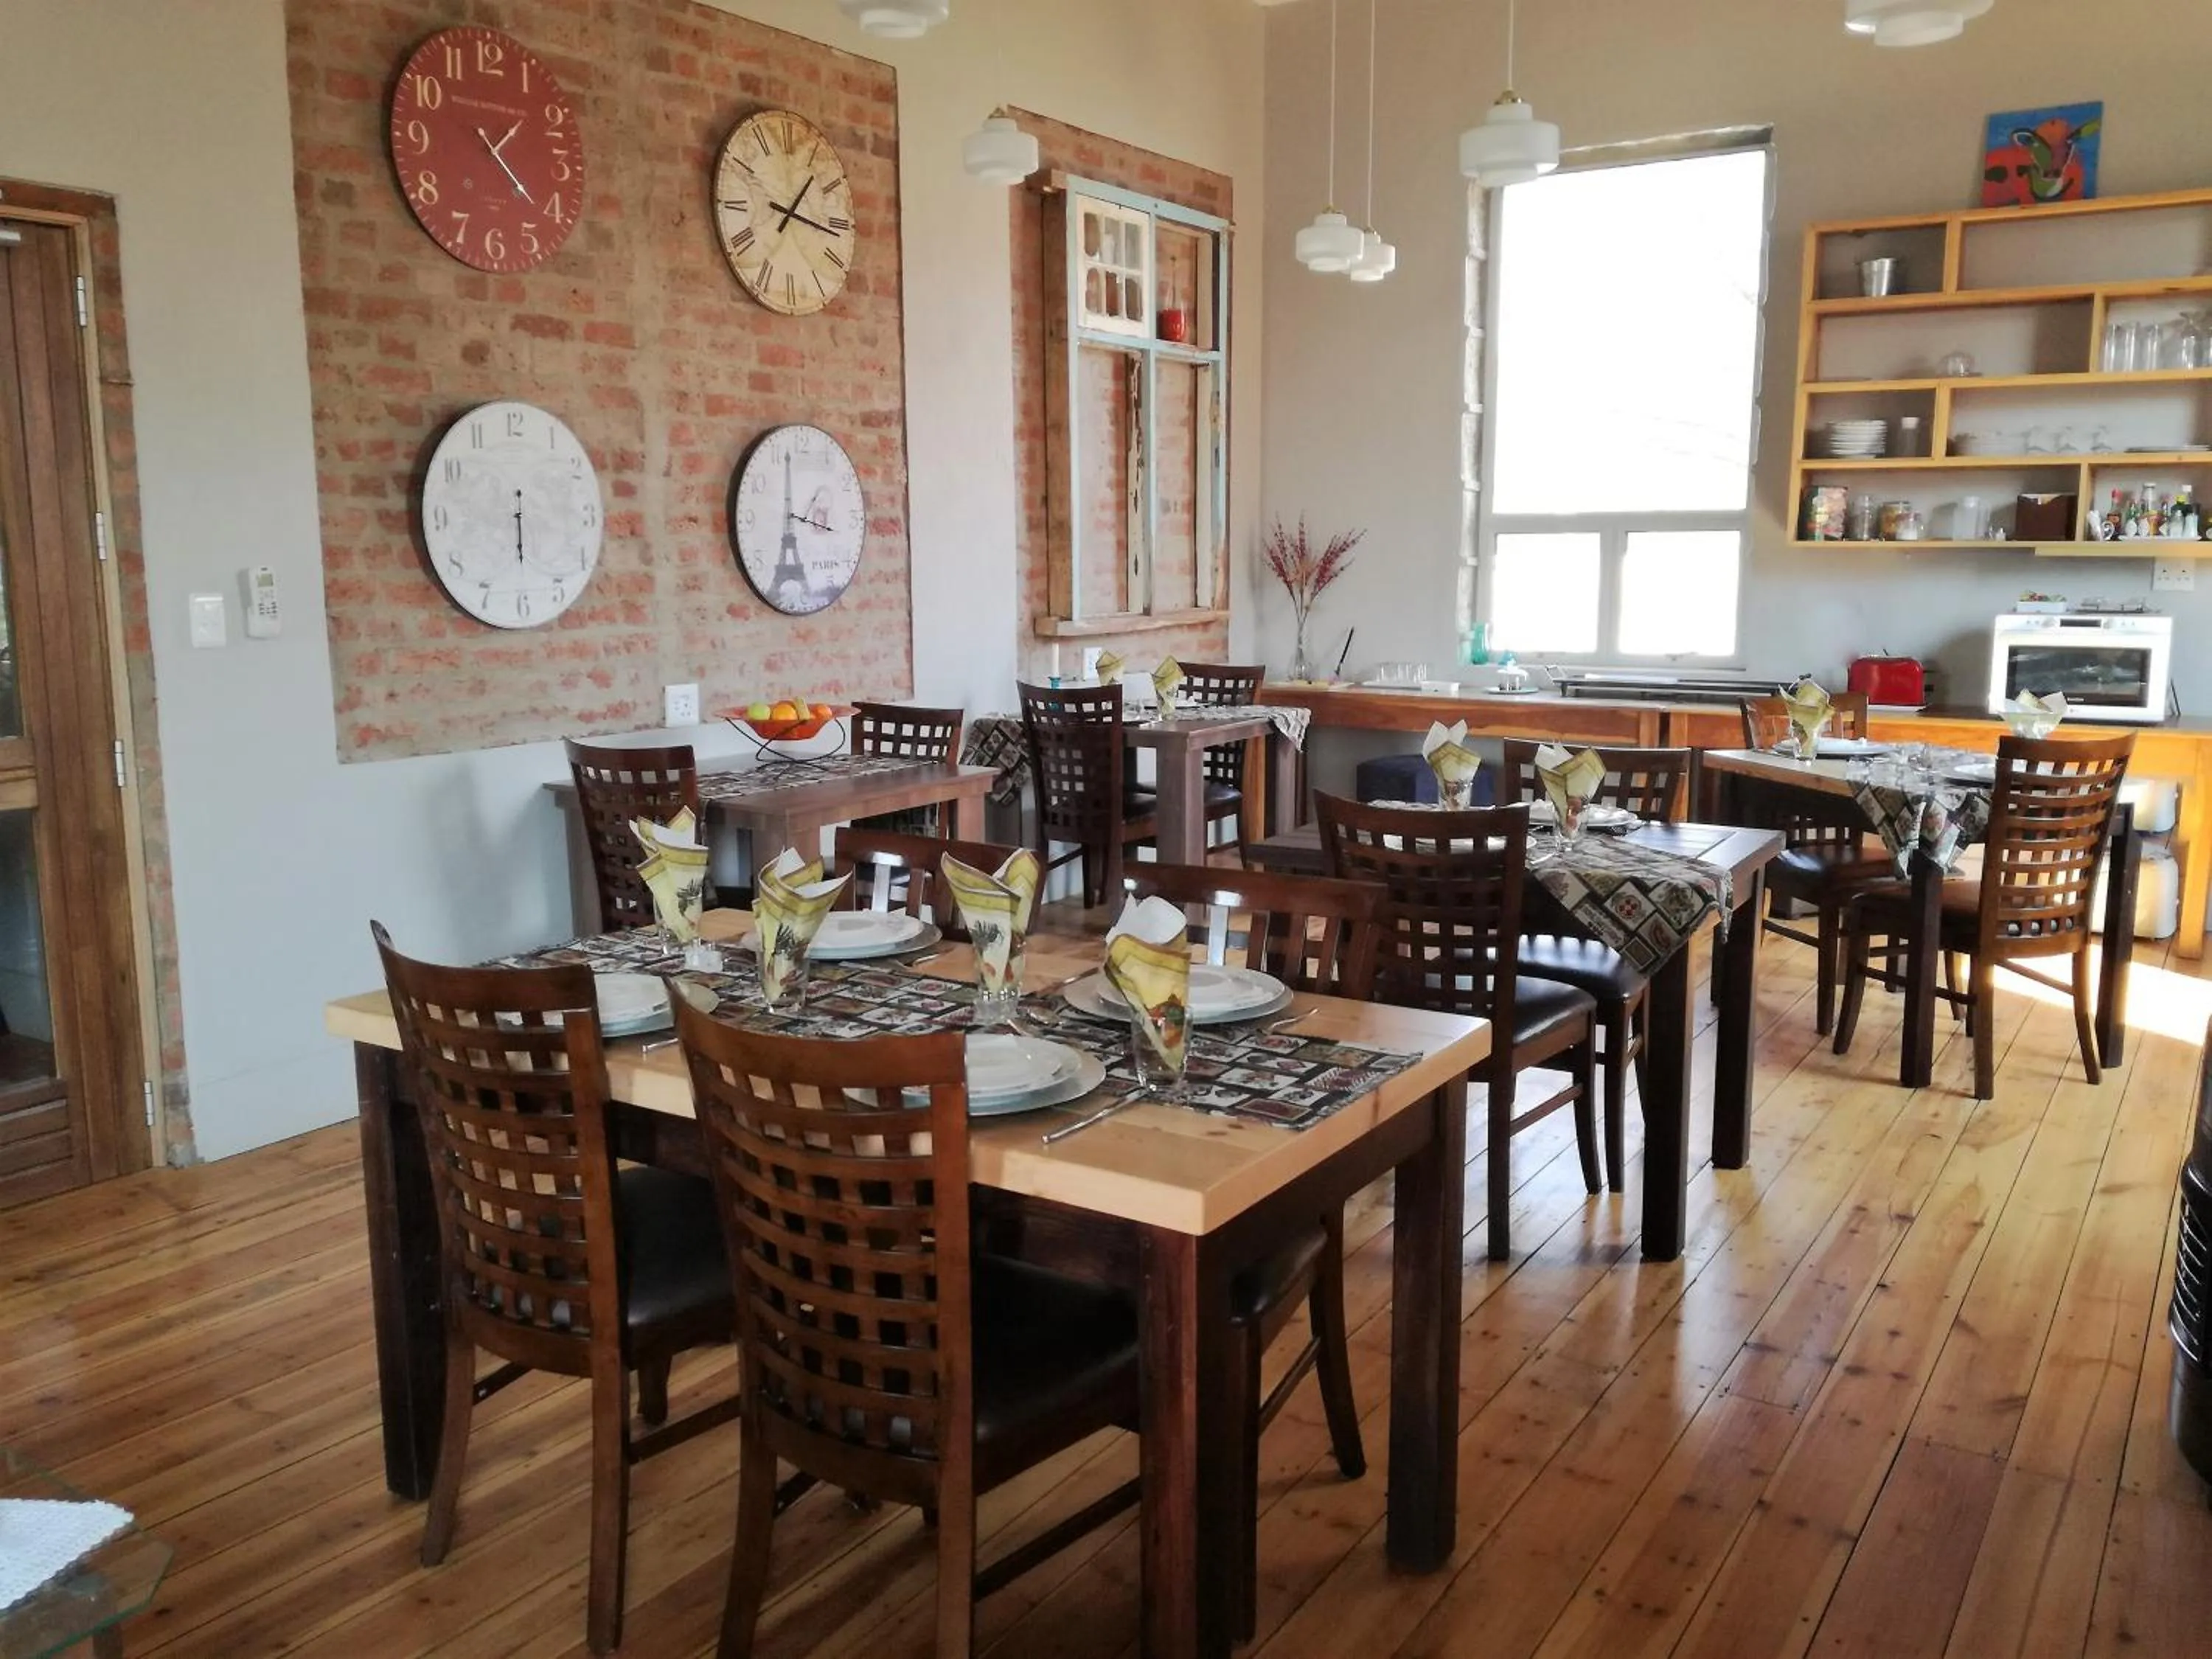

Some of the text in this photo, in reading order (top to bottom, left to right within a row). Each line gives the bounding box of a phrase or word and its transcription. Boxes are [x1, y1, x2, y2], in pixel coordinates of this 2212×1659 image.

[446, 45, 463, 80] 11
[477, 40, 504, 77] 12
[415, 74, 442, 110] 10
[521, 61, 529, 94] 1
[408, 119, 430, 154] 9
[543, 103, 564, 139] 2
[551, 147, 571, 181] 3
[417, 170, 439, 205] 8
[543, 191, 565, 224] 4
[451, 210, 470, 244] 7
[519, 221, 539, 254] 5
[484, 228, 505, 260] 6
[471, 422, 484, 449] 11
[507, 411, 524, 438] 12
[444, 457, 462, 483] 10
[570, 457, 582, 481] 2
[434, 504, 448, 532] 9
[582, 504, 596, 528] 3
[448, 552, 465, 579] 8
[812, 560, 839, 571] PARIS
[478, 578, 492, 611] 7
[516, 592, 530, 619] 6
[552, 577, 566, 603] 5
